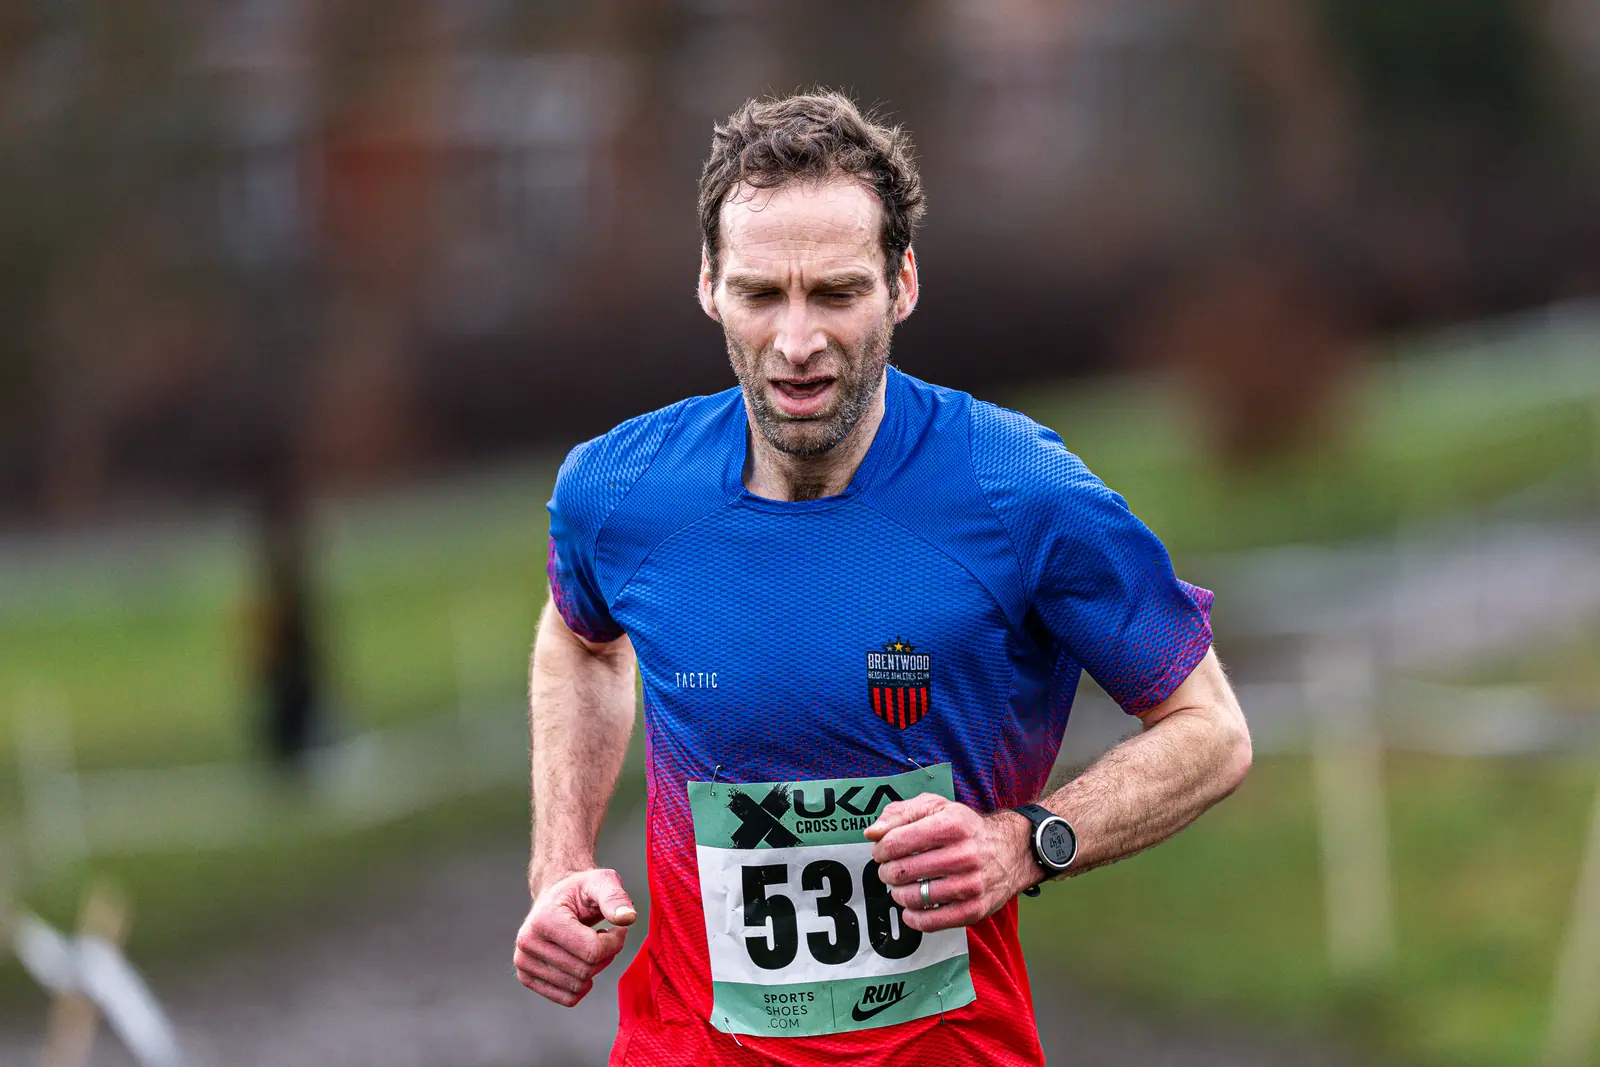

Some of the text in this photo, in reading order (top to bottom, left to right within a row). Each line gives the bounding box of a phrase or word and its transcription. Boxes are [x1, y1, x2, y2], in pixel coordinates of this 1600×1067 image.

[868, 653, 930, 671] BRENTWOOD
[675, 672, 718, 689] TACTIC
[793, 784, 905, 818] UKA
[796, 819, 838, 834] CROSS
[741, 859, 923, 971] 536
[764, 991, 815, 1004] SPORTS
[862, 981, 905, 1005] RUN
[766, 1004, 808, 1017] SHOES
[767, 1018, 800, 1029] .COM
